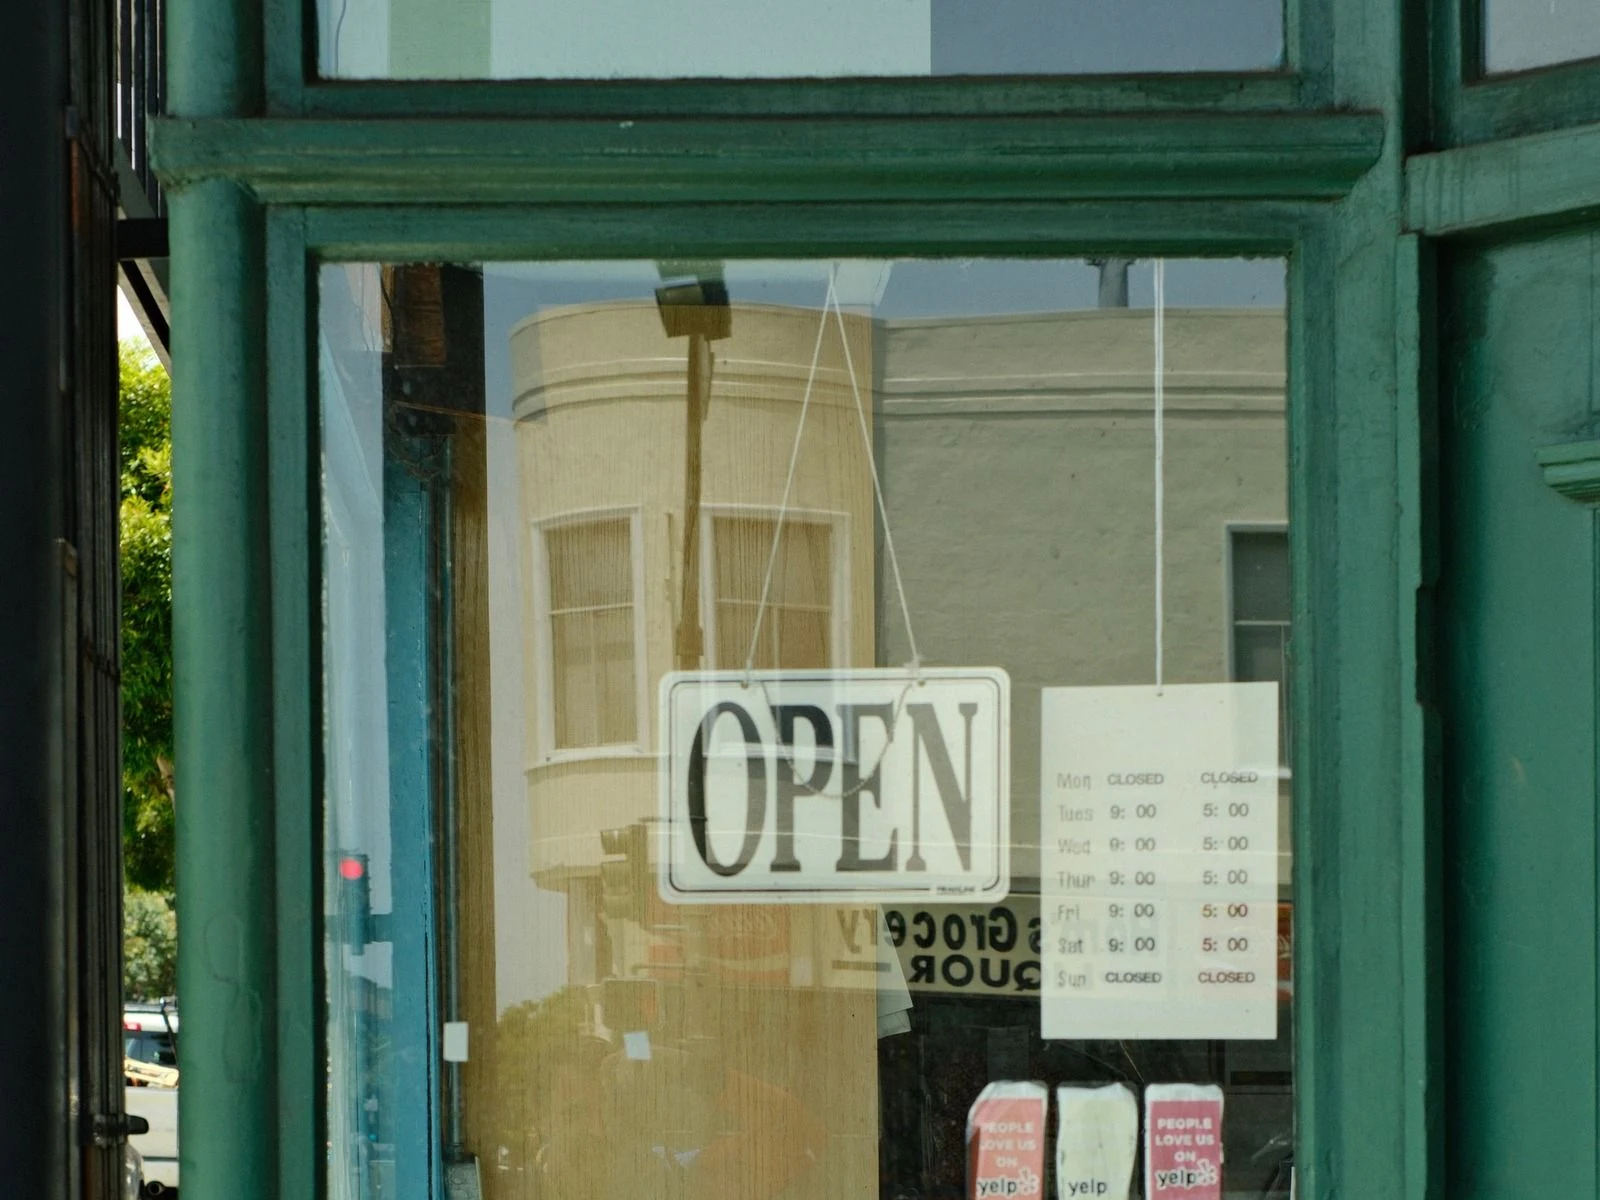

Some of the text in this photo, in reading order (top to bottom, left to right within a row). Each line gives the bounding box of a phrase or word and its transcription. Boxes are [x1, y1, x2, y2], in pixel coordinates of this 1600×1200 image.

[688, 701, 979, 877] OPEN
[1056, 771, 1258, 790] Mon CLOSED CLOSED
[1057, 805, 1094, 822] Tues
[1057, 838, 1091, 855] Wed
[1056, 871, 1096, 889] Thur
[1057, 904, 1080, 920] Fri
[1058, 938, 1084, 954] Sat
[1057, 970, 1256, 988] Sun CLOSED CLOSED
[1157, 1117, 1213, 1130] PEOPLE
[1017, 1139, 1038, 1151] US
[1155, 1134, 1216, 1147] LOVE US
[995, 1156, 1018, 1168] ON
[1174, 1151, 1196, 1163] ON
[1158, 1169, 1197, 1187] yelp
[978, 1178, 1017, 1197] yelp
[1068, 1178, 1107, 1197] yelp
